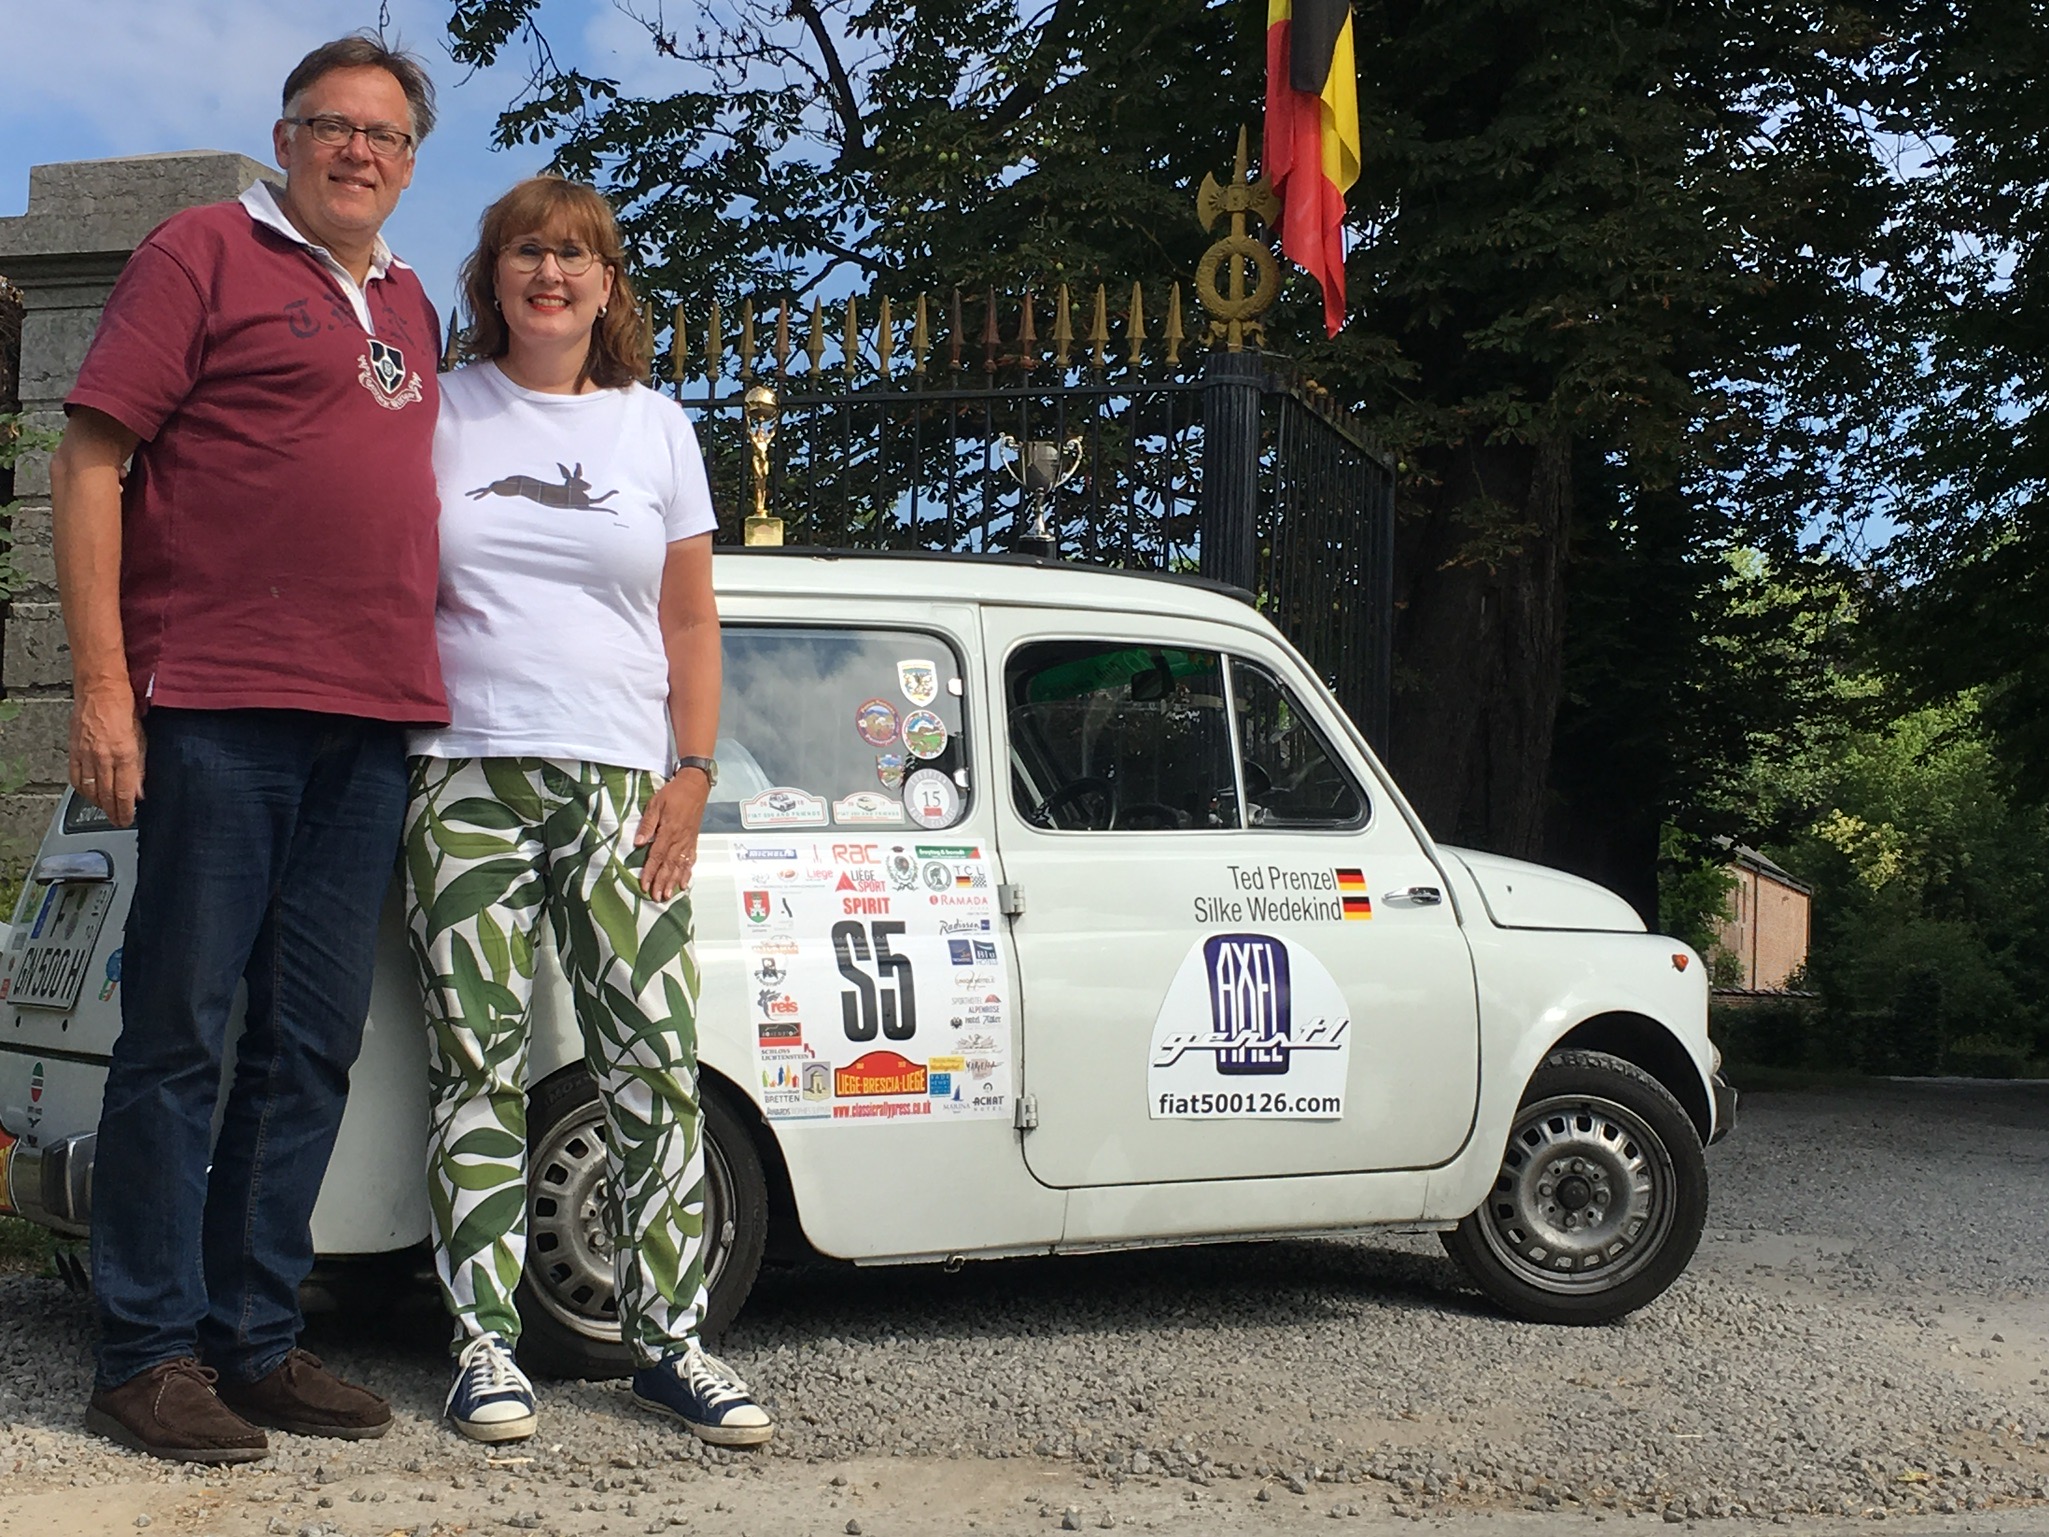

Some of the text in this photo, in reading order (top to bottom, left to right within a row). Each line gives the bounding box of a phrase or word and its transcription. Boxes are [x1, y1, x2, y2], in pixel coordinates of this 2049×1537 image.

[922, 790, 941, 807] 15
[858, 880, 886, 893] SPORT
[1227, 865, 1338, 891] Ted Prenzel
[842, 897, 891, 914] SPIRIT
[1194, 896, 1343, 923] Silke Wedekind
[939, 918, 981, 935] Radisson
[976, 950, 996, 959] Blu
[831, 919, 917, 1042] S5
[770, 995, 799, 1013] reis
[1215, 942, 1284, 1063] AXEL
[764, 1094, 800, 1103] BRETTEN
[972, 1095, 1005, 1106] ACHAT
[1158, 1093, 1342, 1115] fiat500126.com
[833, 1099, 931, 1119] www.classicrallypress.co.uk
